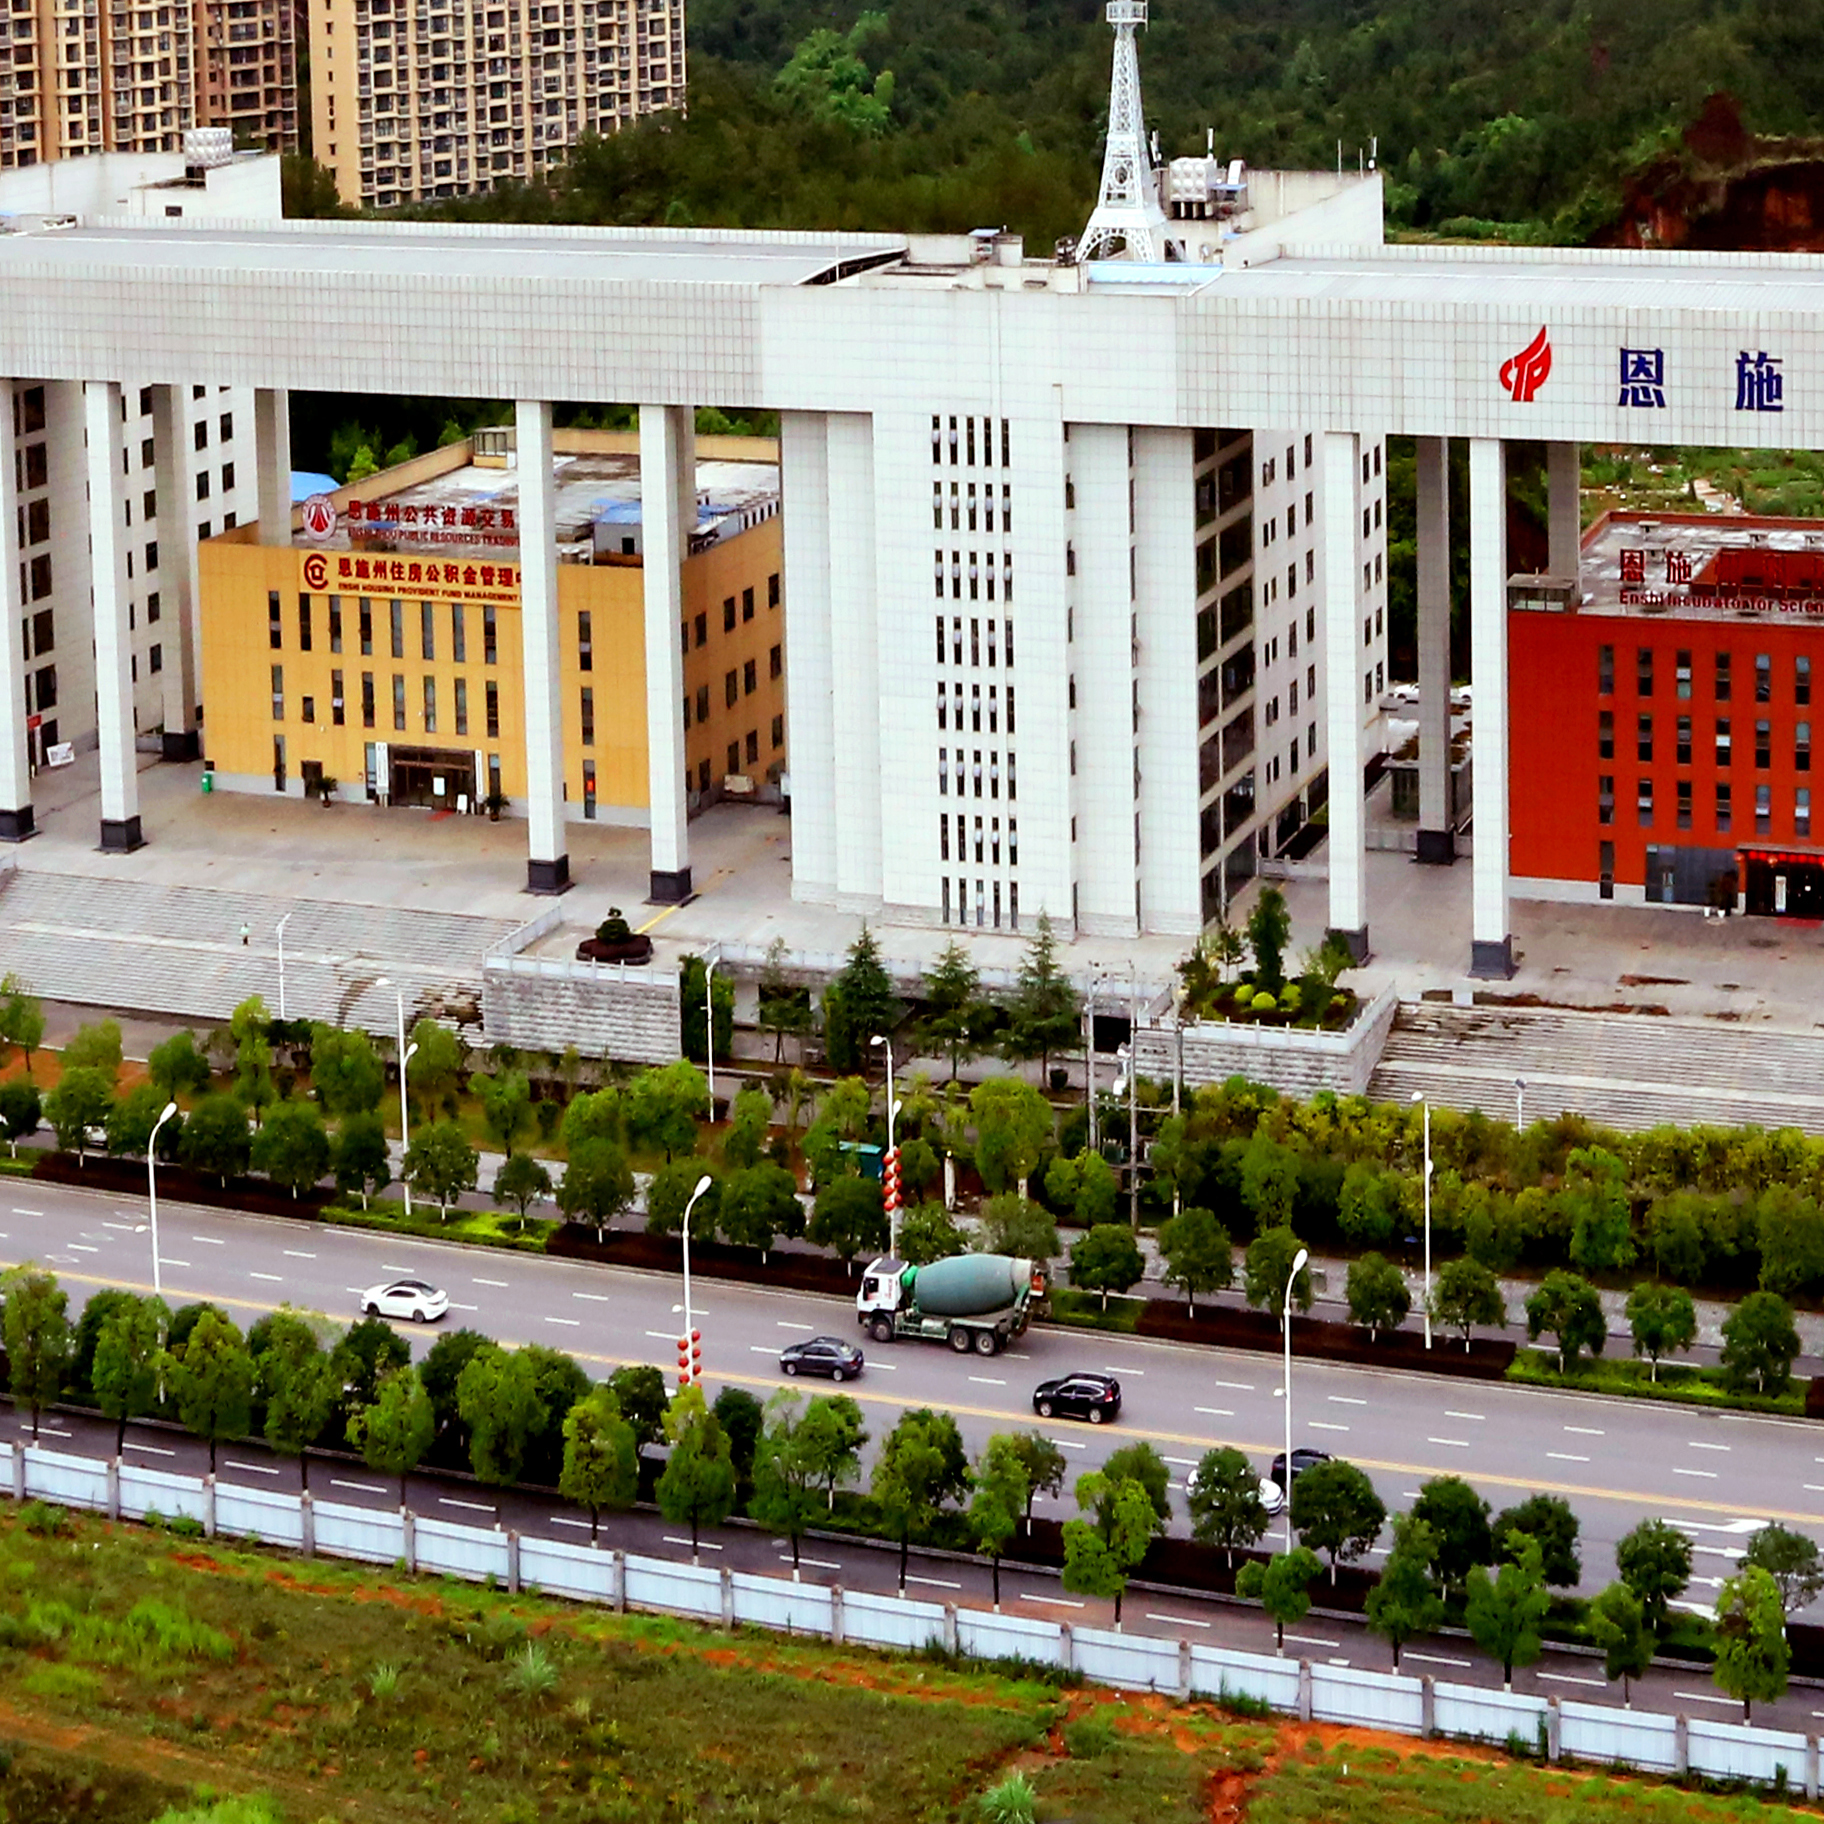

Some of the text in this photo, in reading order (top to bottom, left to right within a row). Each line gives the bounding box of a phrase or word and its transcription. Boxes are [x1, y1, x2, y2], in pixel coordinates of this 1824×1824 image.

[348, 500, 516, 529] 恩施州公共资源交易
[397, 586, 440, 596] PROVIDENT
[442, 589, 462, 598] FUND
[464, 590, 518, 601] MANAGEMENT
[1619, 589, 1663, 606] Enshi
